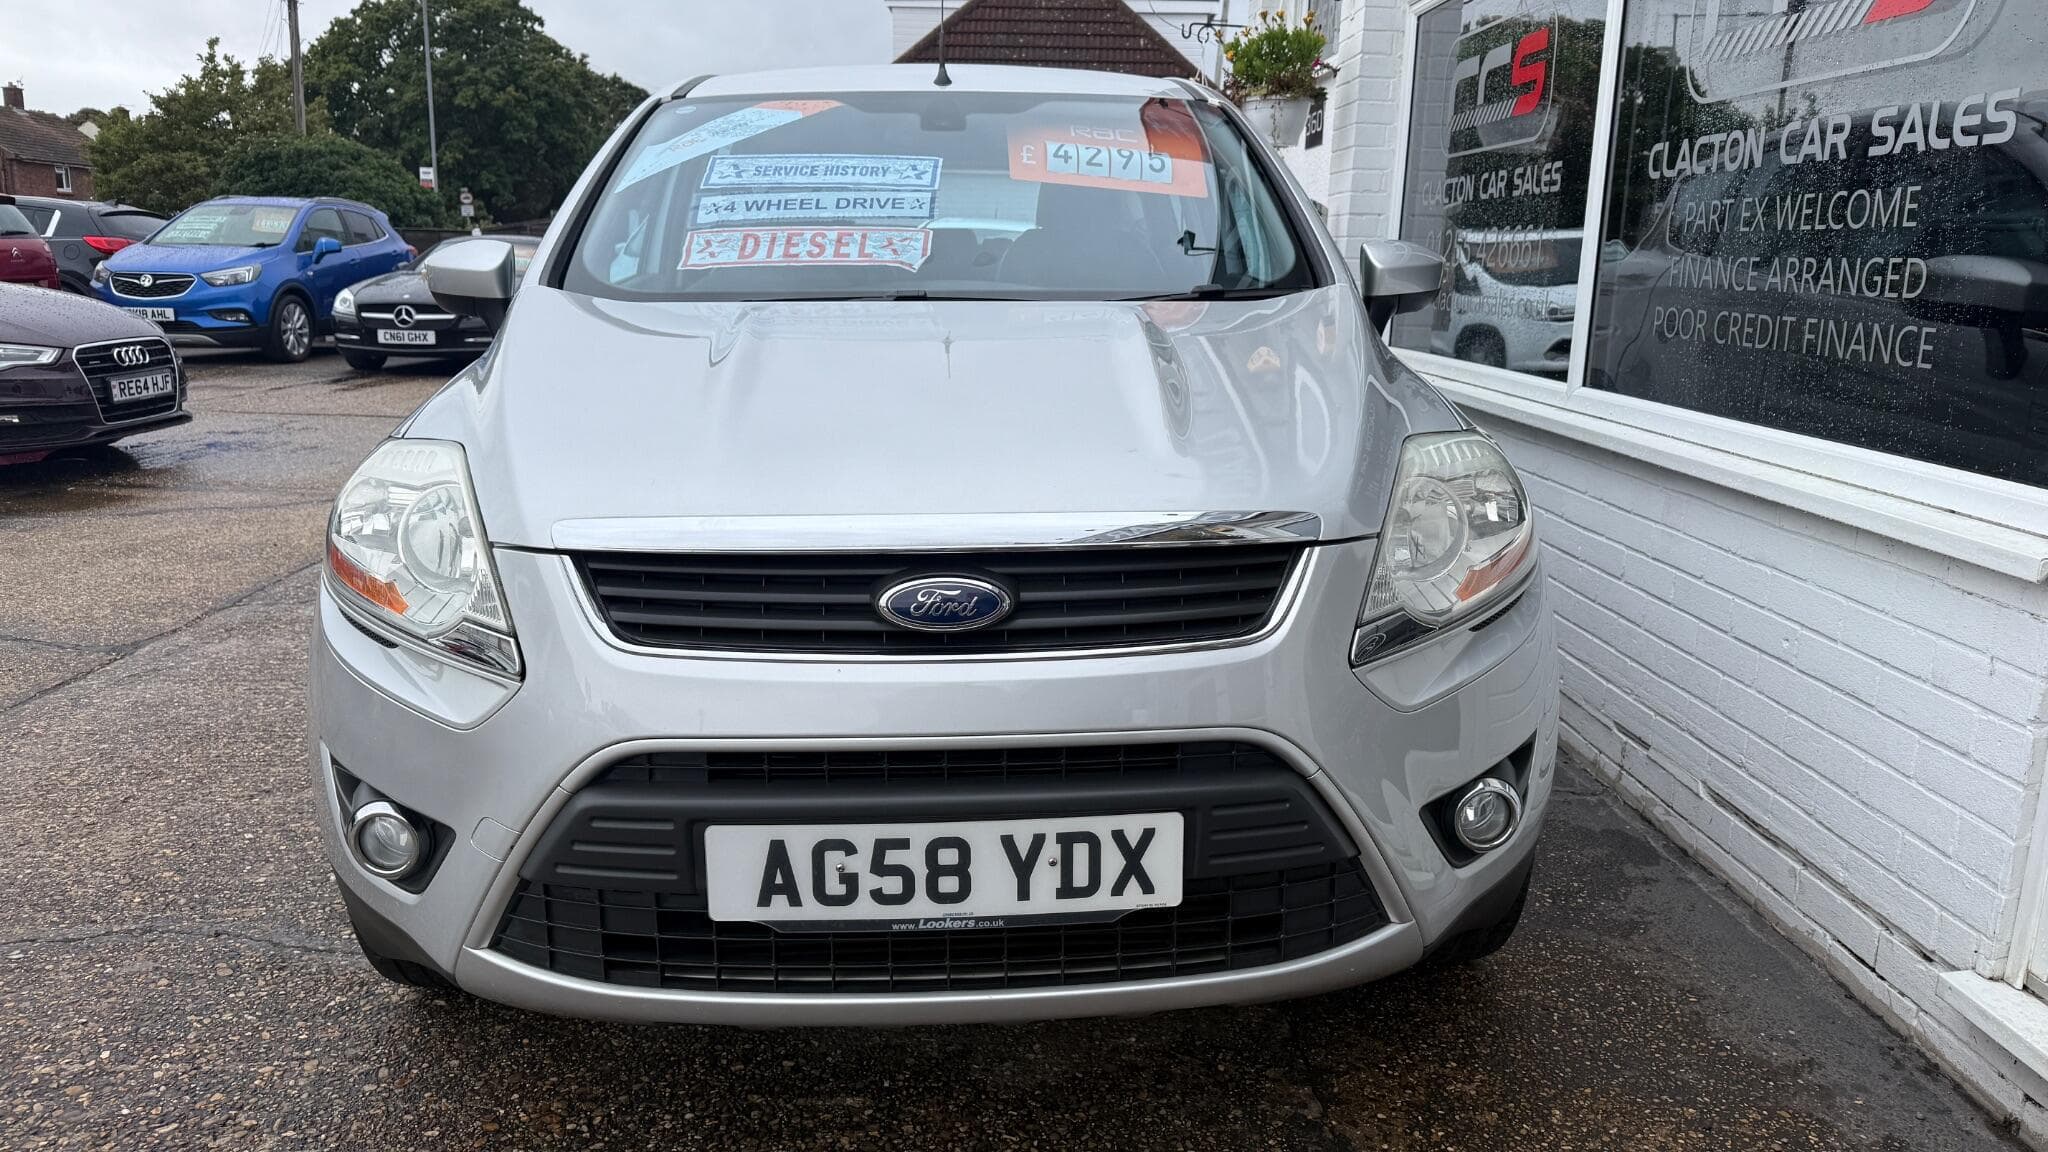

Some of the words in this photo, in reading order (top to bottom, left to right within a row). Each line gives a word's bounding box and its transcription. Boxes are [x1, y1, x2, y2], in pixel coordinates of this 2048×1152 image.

[1649, 127, 1767, 180] CLACTON
[1779, 114, 1852, 165] CAR
[1867, 87, 2023, 158] SALES
[752, 164, 819, 178] SERVICE
[823, 164, 891, 178] HISTORY
[1019, 144, 1037, 166] £
[1052, 143, 1166, 173] 4295
[1422, 174, 1476, 207] CLACTON
[1479, 169, 1508, 200] CAR
[1512, 160, 1563, 197] SALES
[723, 200, 737, 213] 4
[744, 198, 828, 213] WHEEL
[834, 196, 906, 211] DRIVE
[1683, 199, 1735, 234] PART
[1739, 196, 1770, 233] EX
[1775, 185, 1922, 232] WELCOME
[736, 230, 875, 261] DIESEL
[1476, 222, 1546, 269] 426661
[1668, 255, 1761, 292] FINANCE
[1764, 256, 1928, 300] ARRANGED
[151, 308, 170, 320] AHL
[383, 331, 405, 343] CN61
[407, 332, 429, 343] GHX
[1652, 306, 1708, 343] POOR
[1713, 310, 1797, 352] CREDIT
[1802, 317, 1937, 370] FINANCE
[118, 377, 150, 399] RE64
[151, 374, 170, 393] HJF
[910, 588, 979, 617] Ford
[756, 836, 972, 908] AG58
[999, 827, 1156, 902] YDX
[891, 917, 1005, 931] www.Lookers.co.uk
